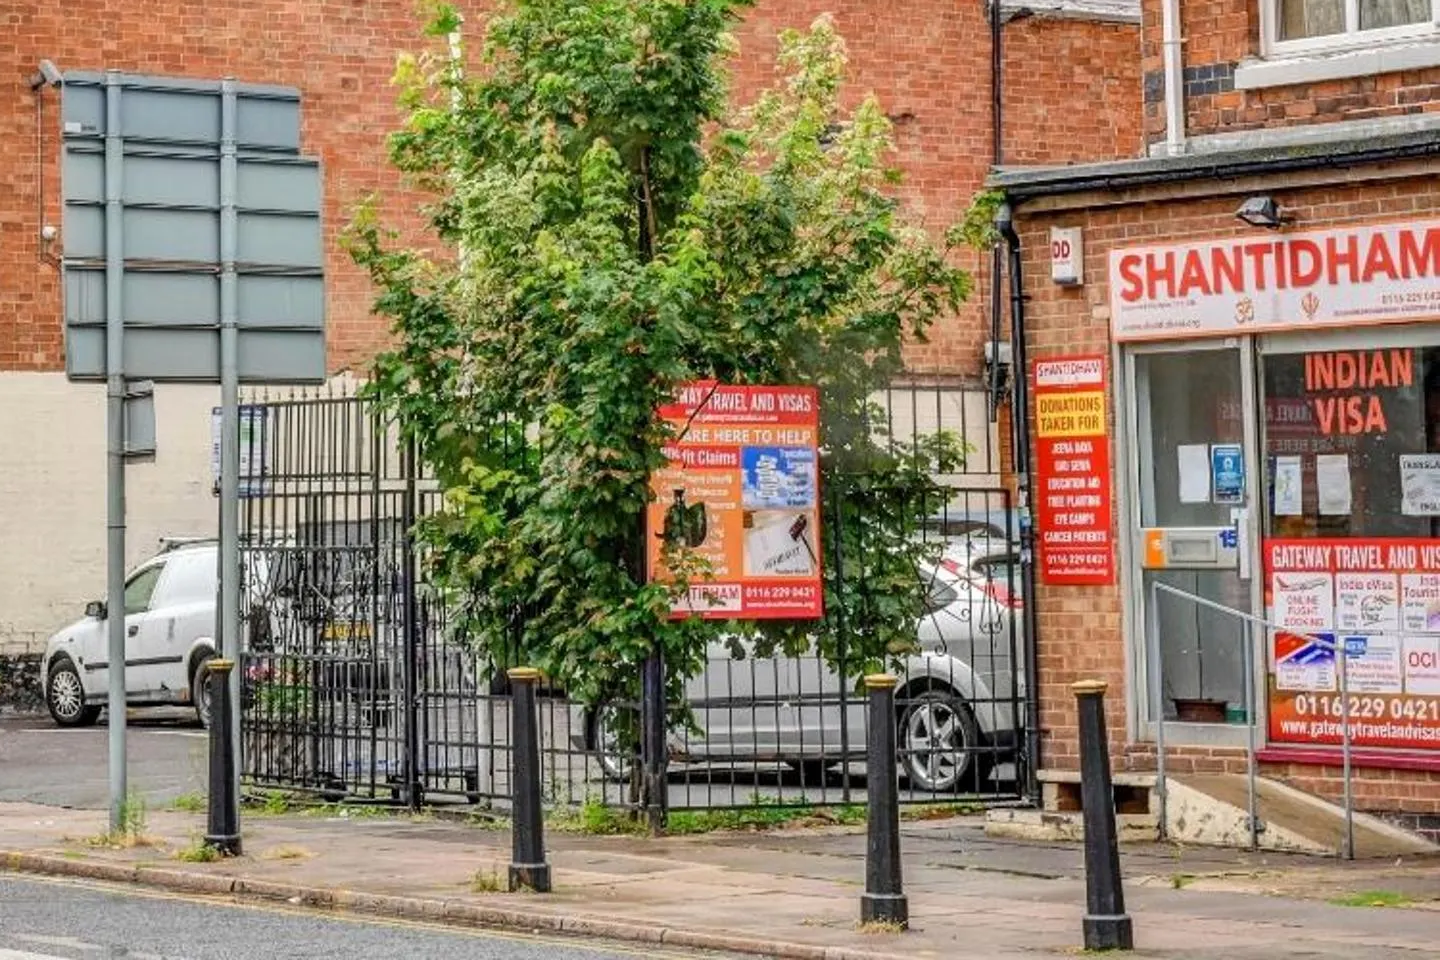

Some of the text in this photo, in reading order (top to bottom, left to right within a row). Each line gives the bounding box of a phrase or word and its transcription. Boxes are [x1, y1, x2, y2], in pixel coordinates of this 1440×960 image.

[1119, 228, 1440, 302] SHANTIDHAM
[1304, 348, 1413, 390] INDIAN
[708, 390, 747, 411] TRAVEL
[751, 394, 775, 412] AND
[778, 395, 811, 412] VISAS
[1040, 397, 1101, 413] DONATIONS
[1314, 395, 1388, 434] VISA
[1041, 415, 1099, 431] TAKEN FOR
[682, 429, 811, 444] ARE HERE TO HELP
[698, 450, 737, 466] Claims
[1054, 514, 1068, 525] EYE
[1044, 531, 1072, 542] CANCER
[1272, 545, 1331, 568] GATEWAY
[1334, 545, 1384, 569] TRAVEL
[1388, 545, 1417, 569] AND
[1286, 595, 1319, 605] ONLINE
[1284, 617, 1324, 627] BOOKING
[1408, 651, 1437, 669] OCI
[1295, 694, 1440, 720] 0116 229 0421
